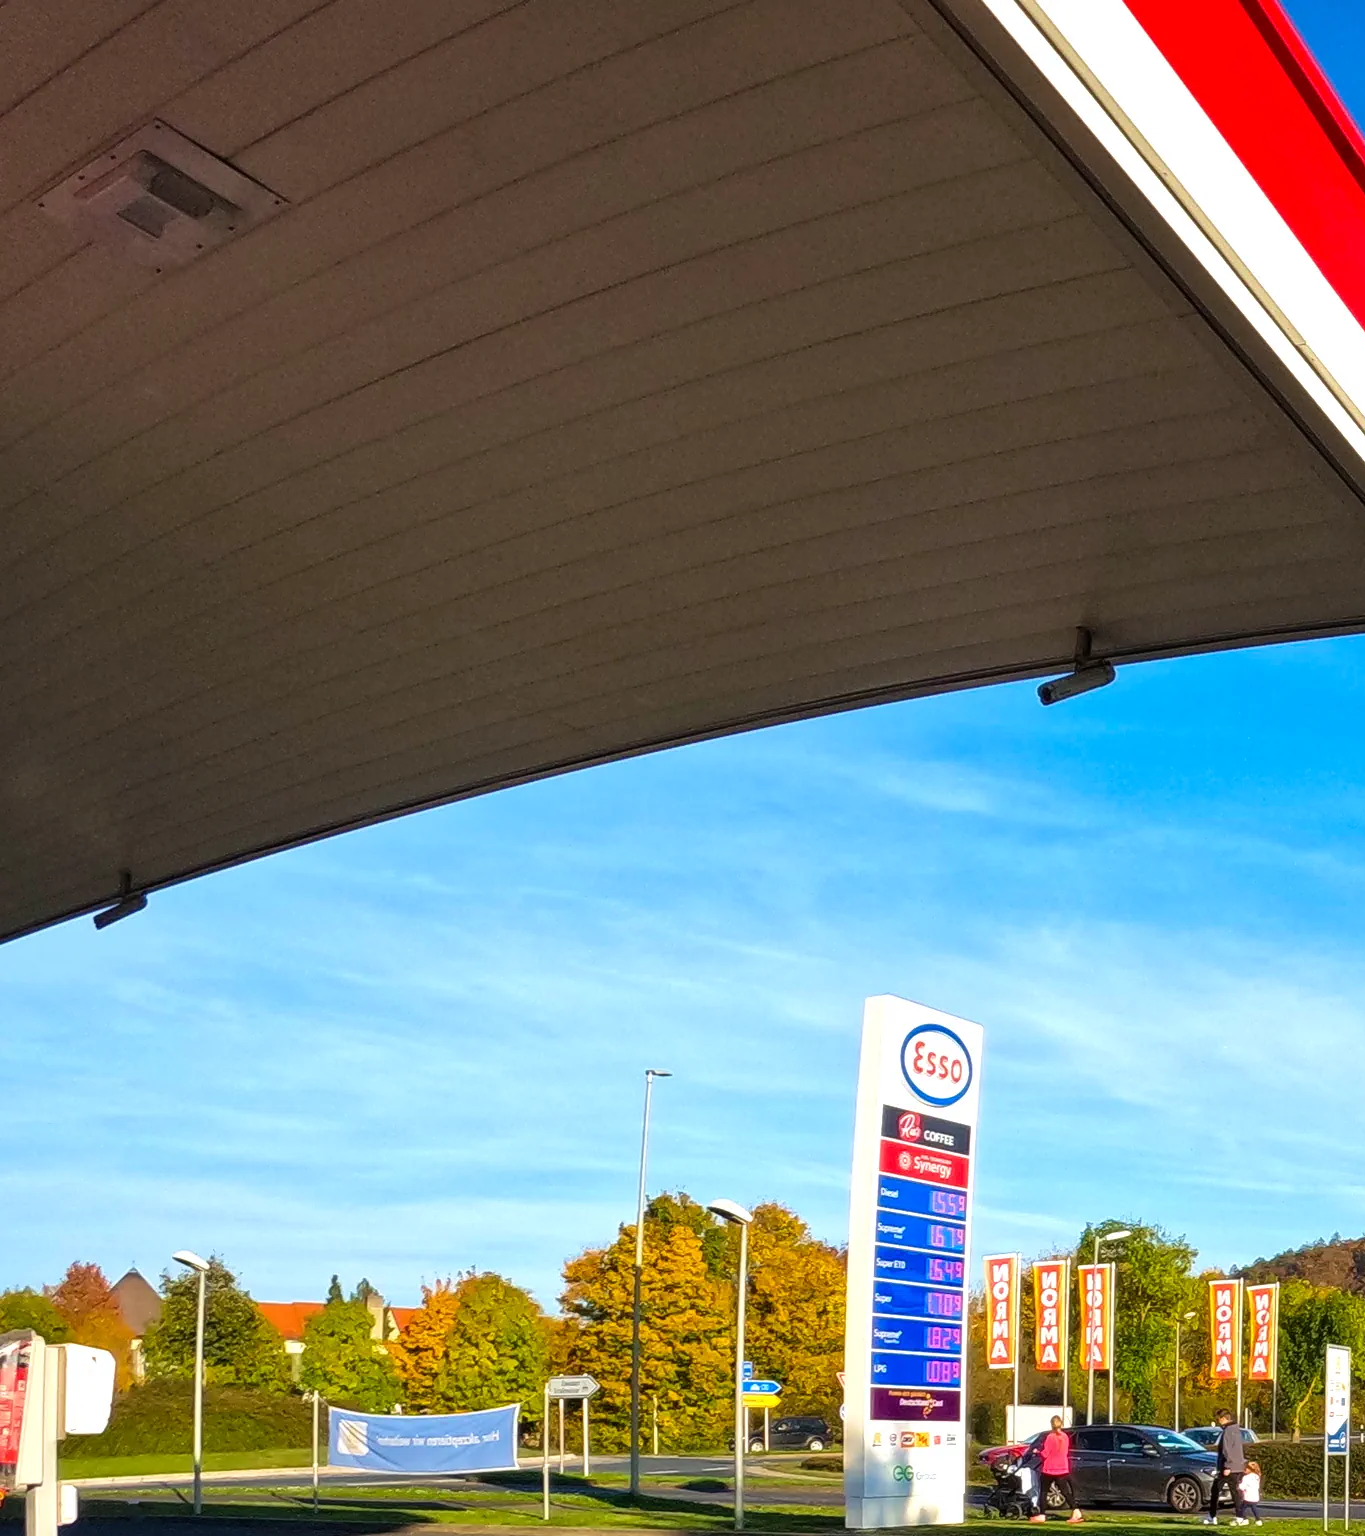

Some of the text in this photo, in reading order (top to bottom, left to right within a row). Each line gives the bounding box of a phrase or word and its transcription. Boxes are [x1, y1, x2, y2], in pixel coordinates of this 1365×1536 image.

[923, 1130, 955, 1147] COFFEE
[913, 1156, 952, 1179] Synergy
[876, 1258, 893, 1269] Super
[874, 1292, 892, 1304] Super
[873, 1364, 887, 1373] LPG
